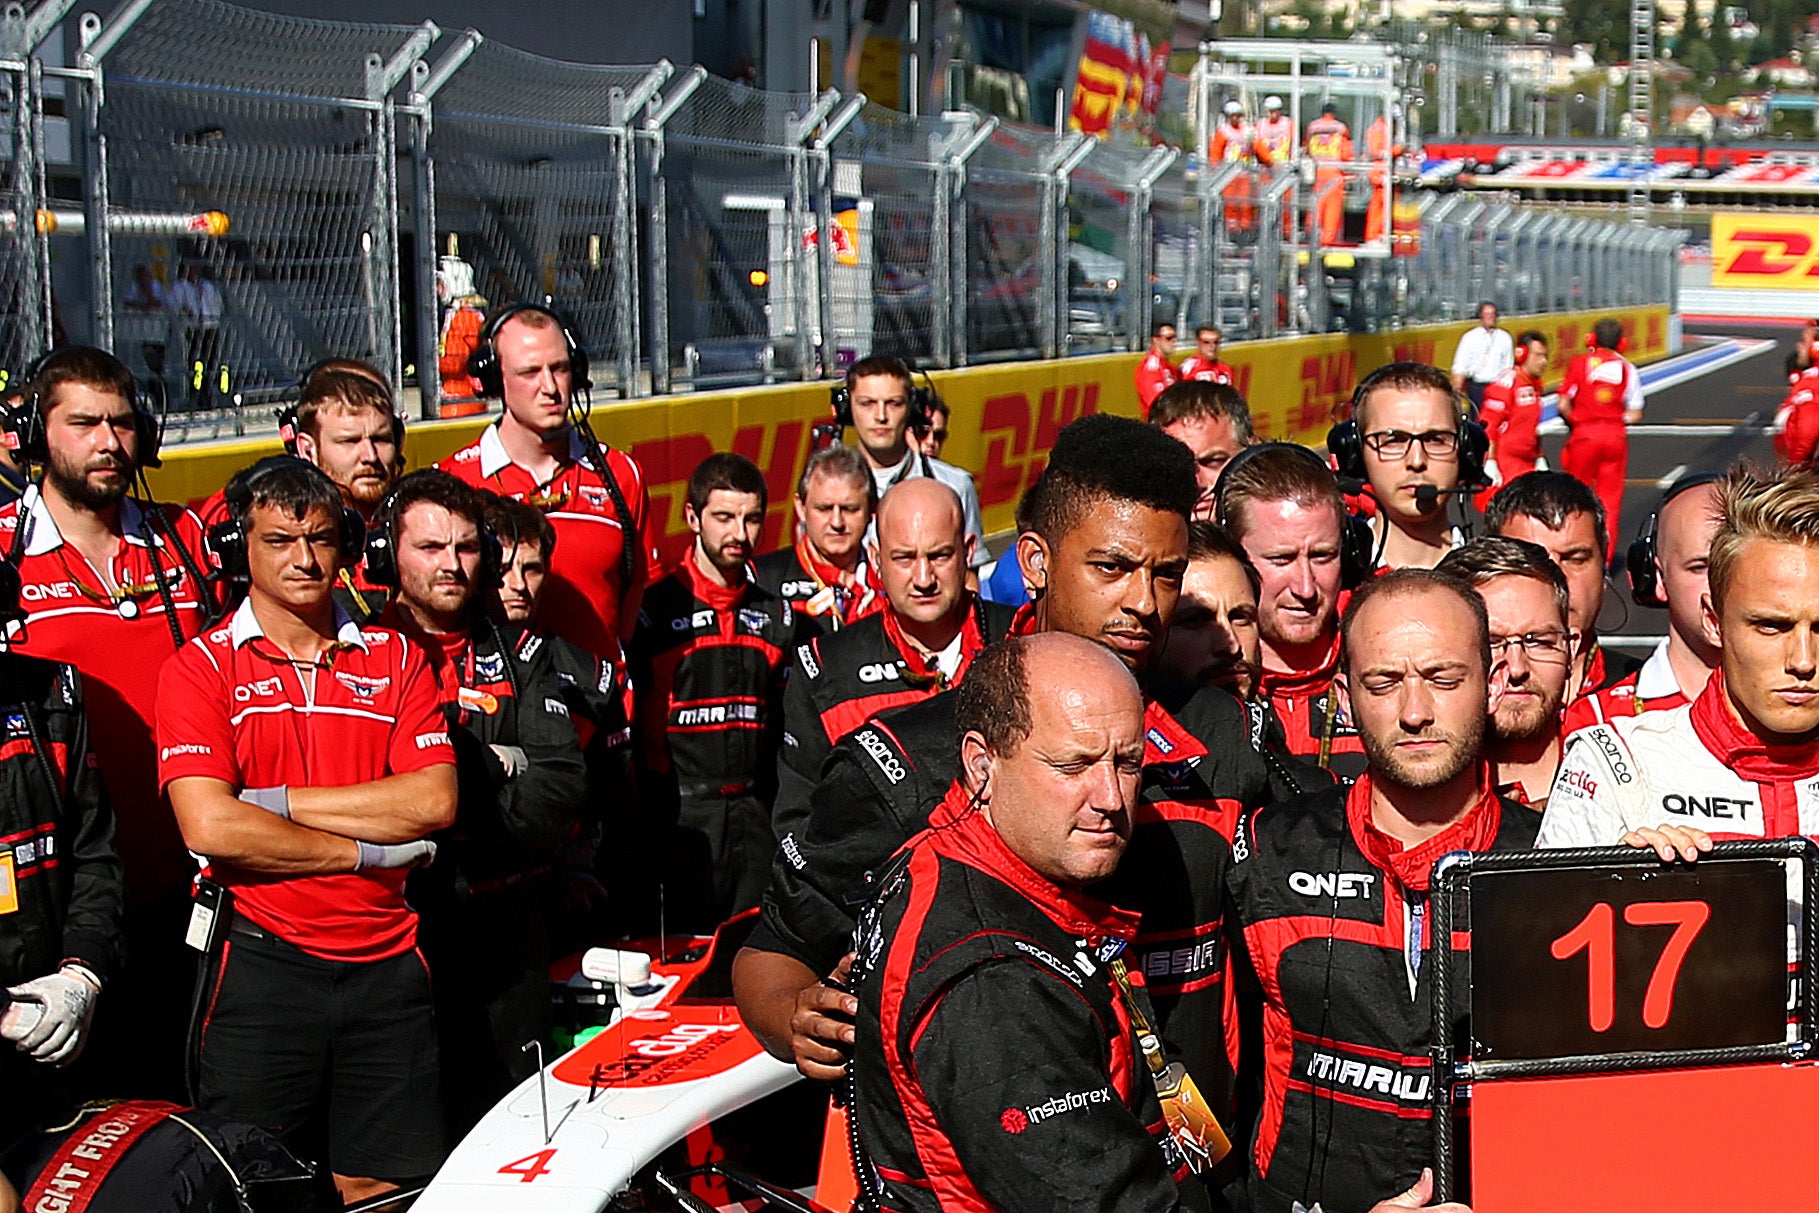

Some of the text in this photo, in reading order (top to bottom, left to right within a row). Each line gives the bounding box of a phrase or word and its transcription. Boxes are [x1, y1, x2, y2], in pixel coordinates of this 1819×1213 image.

[854, 730, 907, 786] sparco
[1592, 728, 1633, 785] sparco
[1662, 794, 1755, 821] QNET
[1288, 871, 1375, 899] QNET
[1142, 940, 1216, 977] SSIA
[1552, 900, 1712, 1034] 17
[1307, 1053, 1434, 1101] MARU
[1025, 1087, 1111, 1125] instaforex
[496, 1148, 560, 1184] 4
